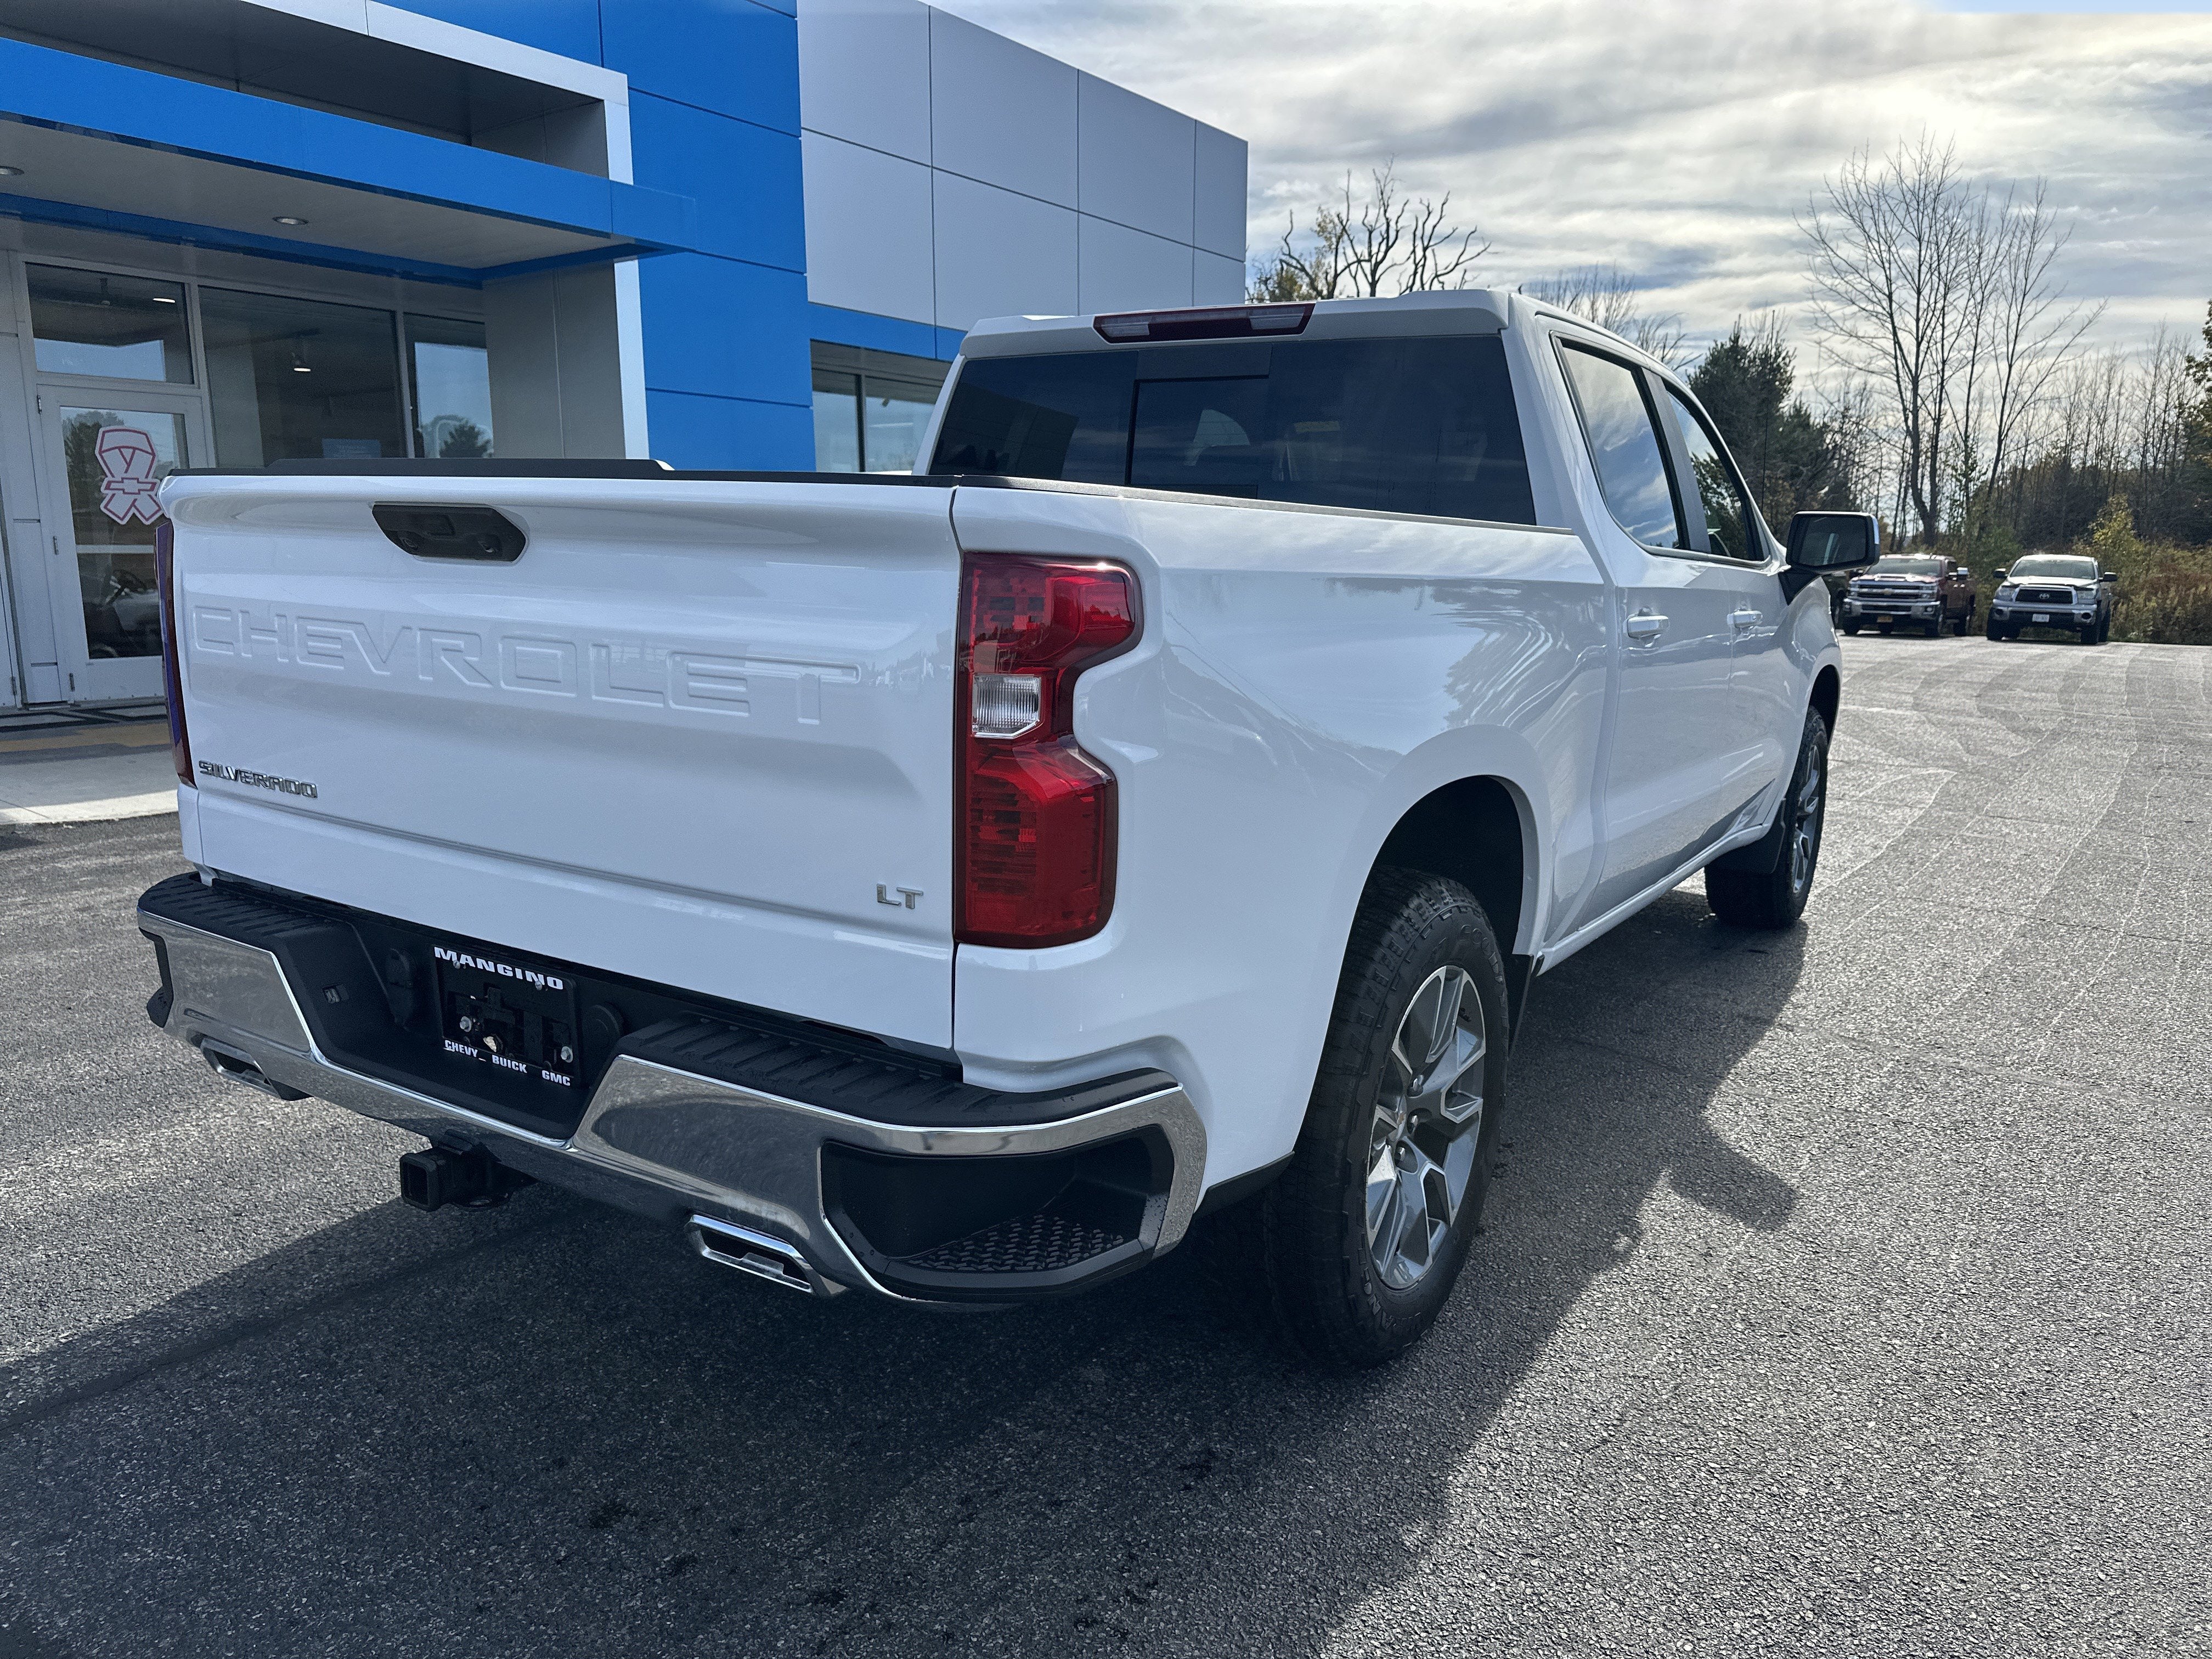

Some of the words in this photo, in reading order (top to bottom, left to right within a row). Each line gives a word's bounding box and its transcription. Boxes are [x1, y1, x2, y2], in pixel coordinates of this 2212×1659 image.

[192, 605, 861, 725] CHEVROLET
[198, 759, 318, 798] SILVERADO
[876, 883, 924, 910] LT
[434, 946, 563, 990] MANGINO
[444, 1040, 478, 1058] CHEVY
[492, 1054, 527, 1074] BUICK
[541, 1070, 571, 1086] GMC
